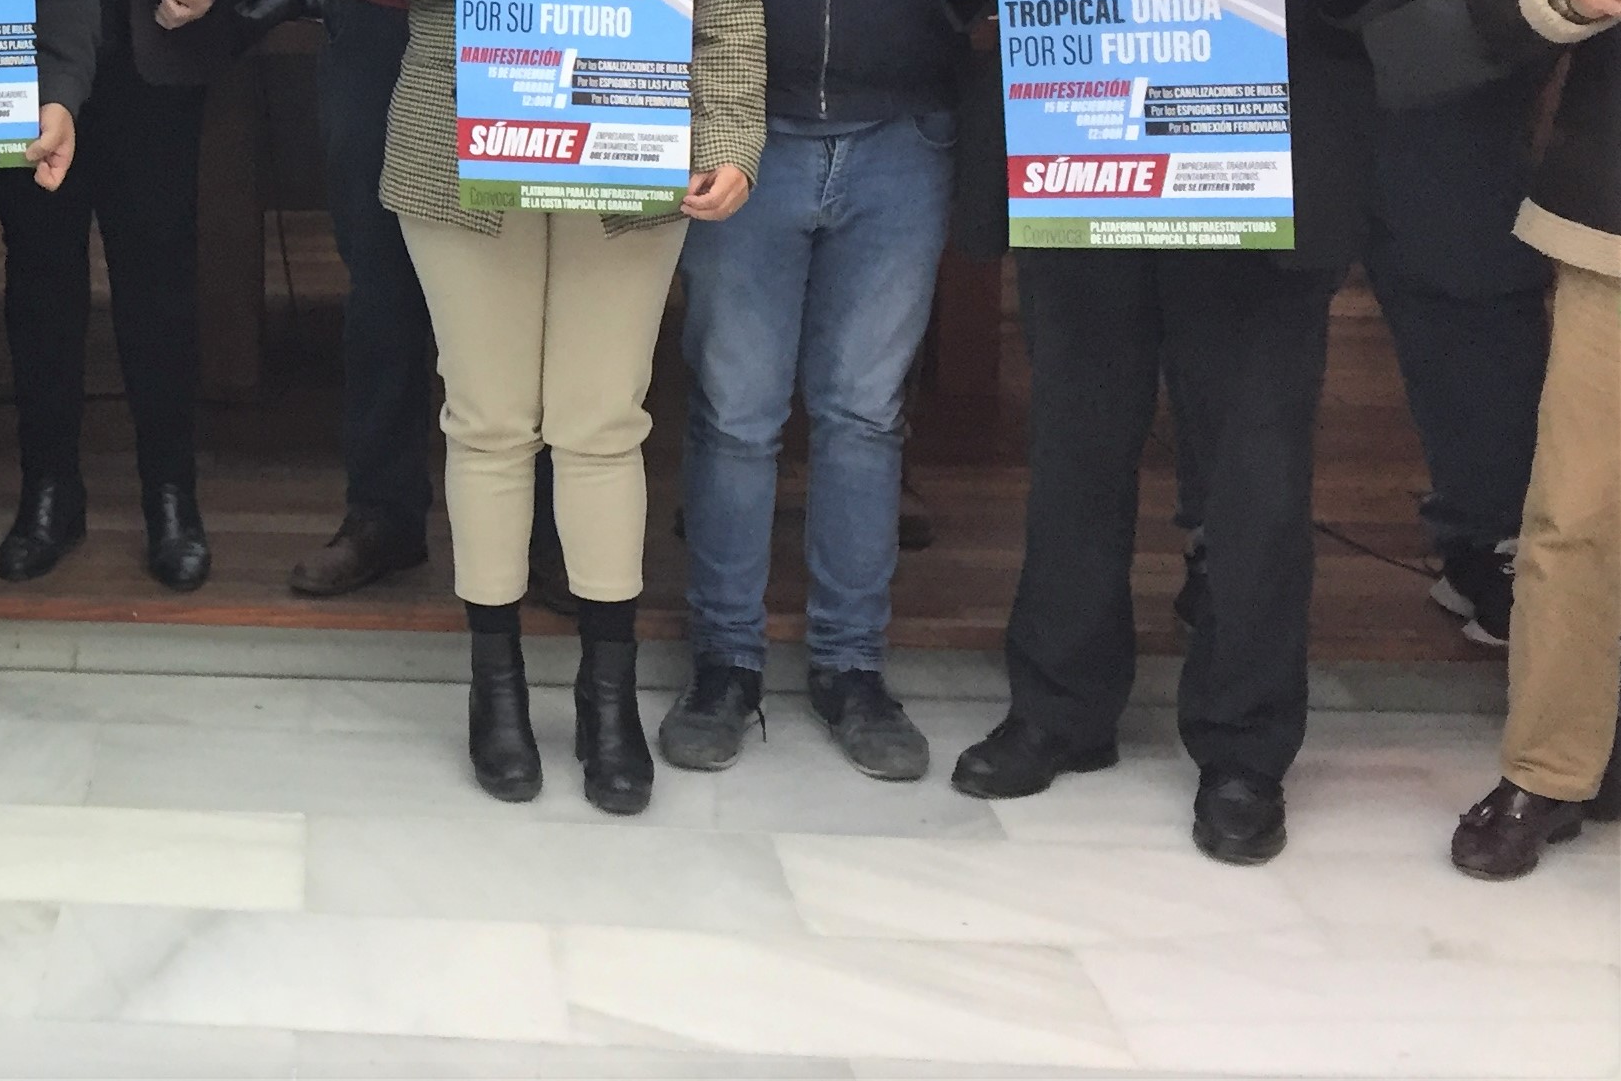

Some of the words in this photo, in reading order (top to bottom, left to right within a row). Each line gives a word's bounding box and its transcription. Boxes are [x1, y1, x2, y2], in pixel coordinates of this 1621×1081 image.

[462, 1, 500, 30] POR
[507, 3, 532, 32] SU
[540, 3, 630, 37] FUTURO
[1010, 36, 1054, 66] POR
[1062, 35, 1092, 64] SU
[1101, 30, 1210, 63] FUTURO
[1176, 104, 1222, 115] ESPIGONES
[1223, 104, 1233, 114] EN
[1235, 103, 1251, 114] LAS
[469, 121, 578, 159] SÚMATE
[1023, 157, 1155, 192] SÚMATE
[1103, 234, 1113, 243] LA
[1170, 221, 1187, 232] LAS
